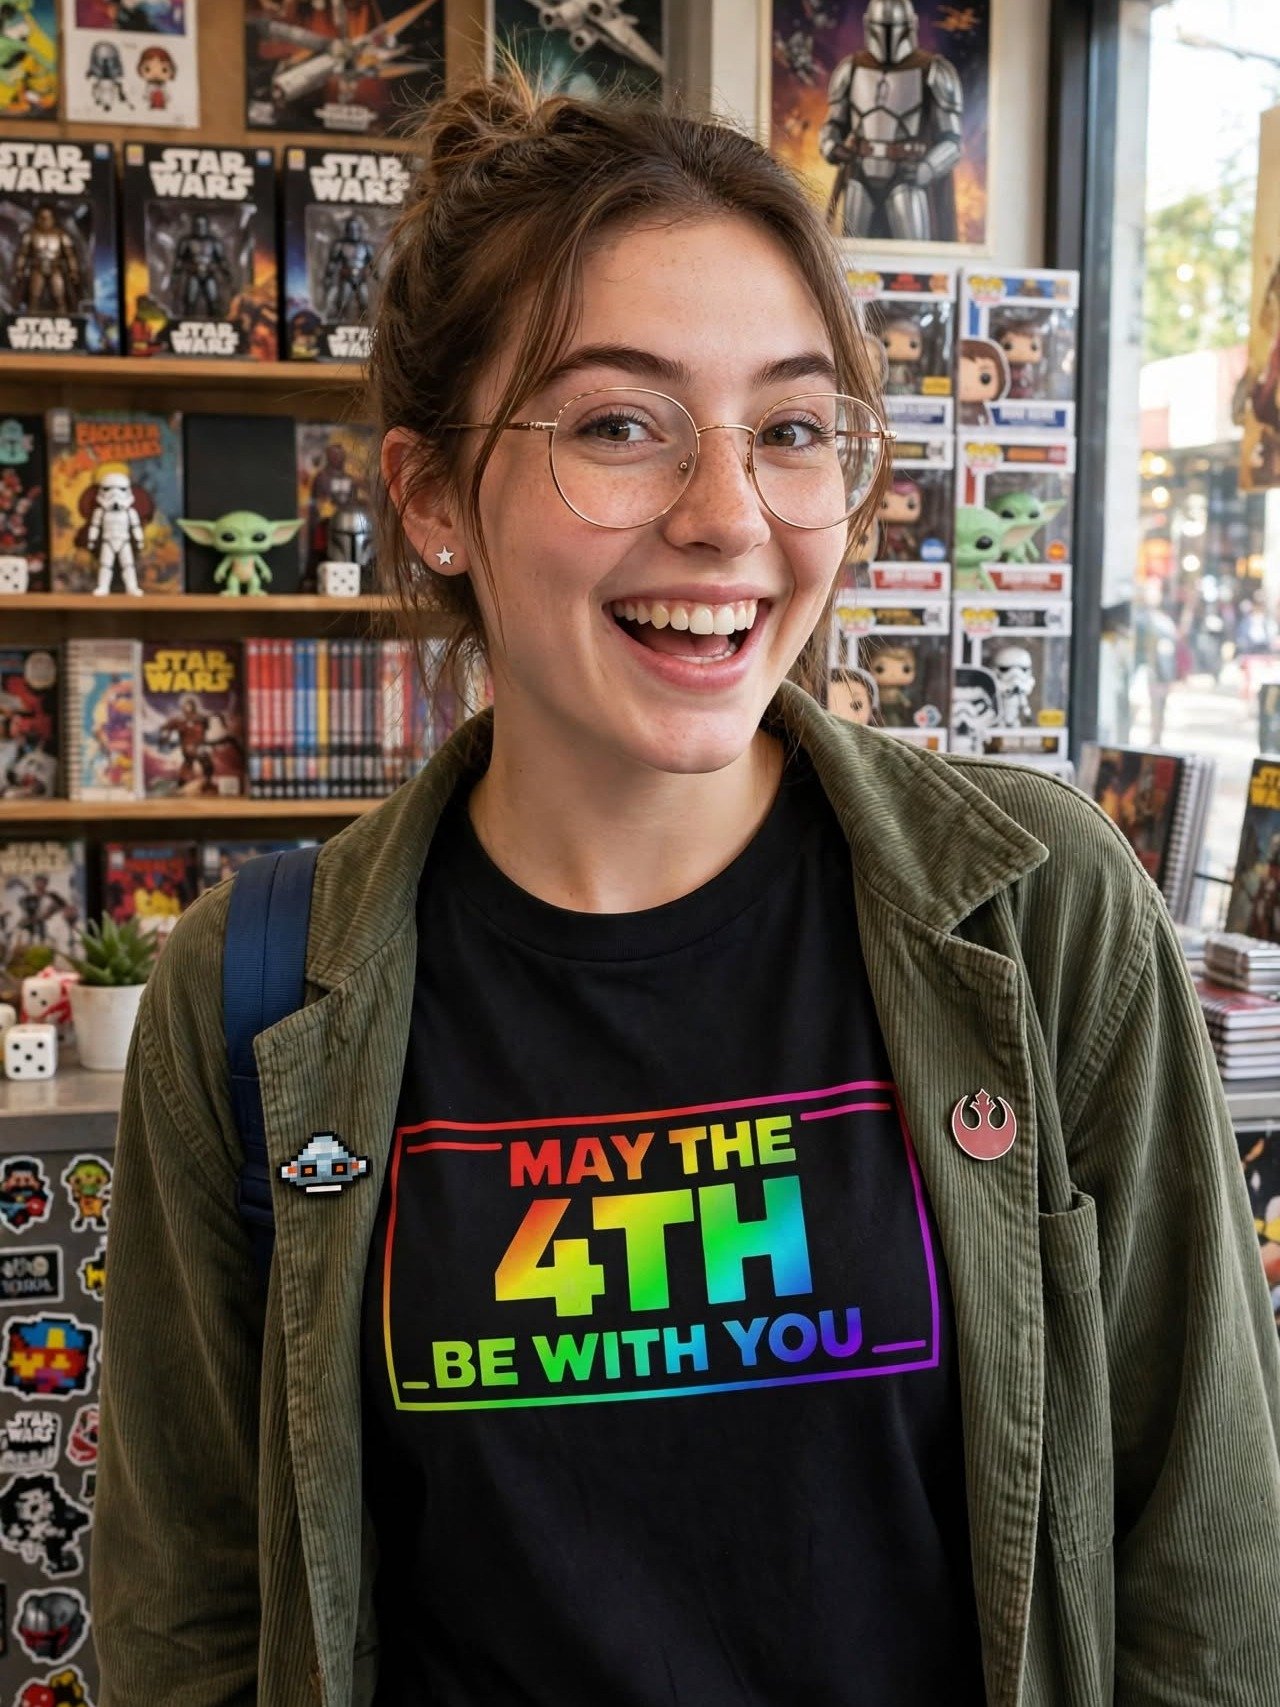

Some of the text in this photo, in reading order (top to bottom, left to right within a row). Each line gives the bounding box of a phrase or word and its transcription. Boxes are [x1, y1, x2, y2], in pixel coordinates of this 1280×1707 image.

[149, 149, 253, 175] STAR
[310, 153, 409, 180] STAR
[149, 171, 254, 200] WARS
[310, 176, 409, 204] WARS
[8, 317, 77, 335] STAR
[170, 322, 239, 339] STAR
[8, 332, 77, 350] WARS
[171, 335, 239, 354] WARS
[144, 650, 234, 672] STAR
[144, 669, 234, 692] WARS
[510, 1115, 796, 1187] MAY THE
[495, 1175, 813, 1317] 4TH
[432, 1307, 862, 1389] BE WITH YOU
[6, 1411, 56, 1429] STAR
